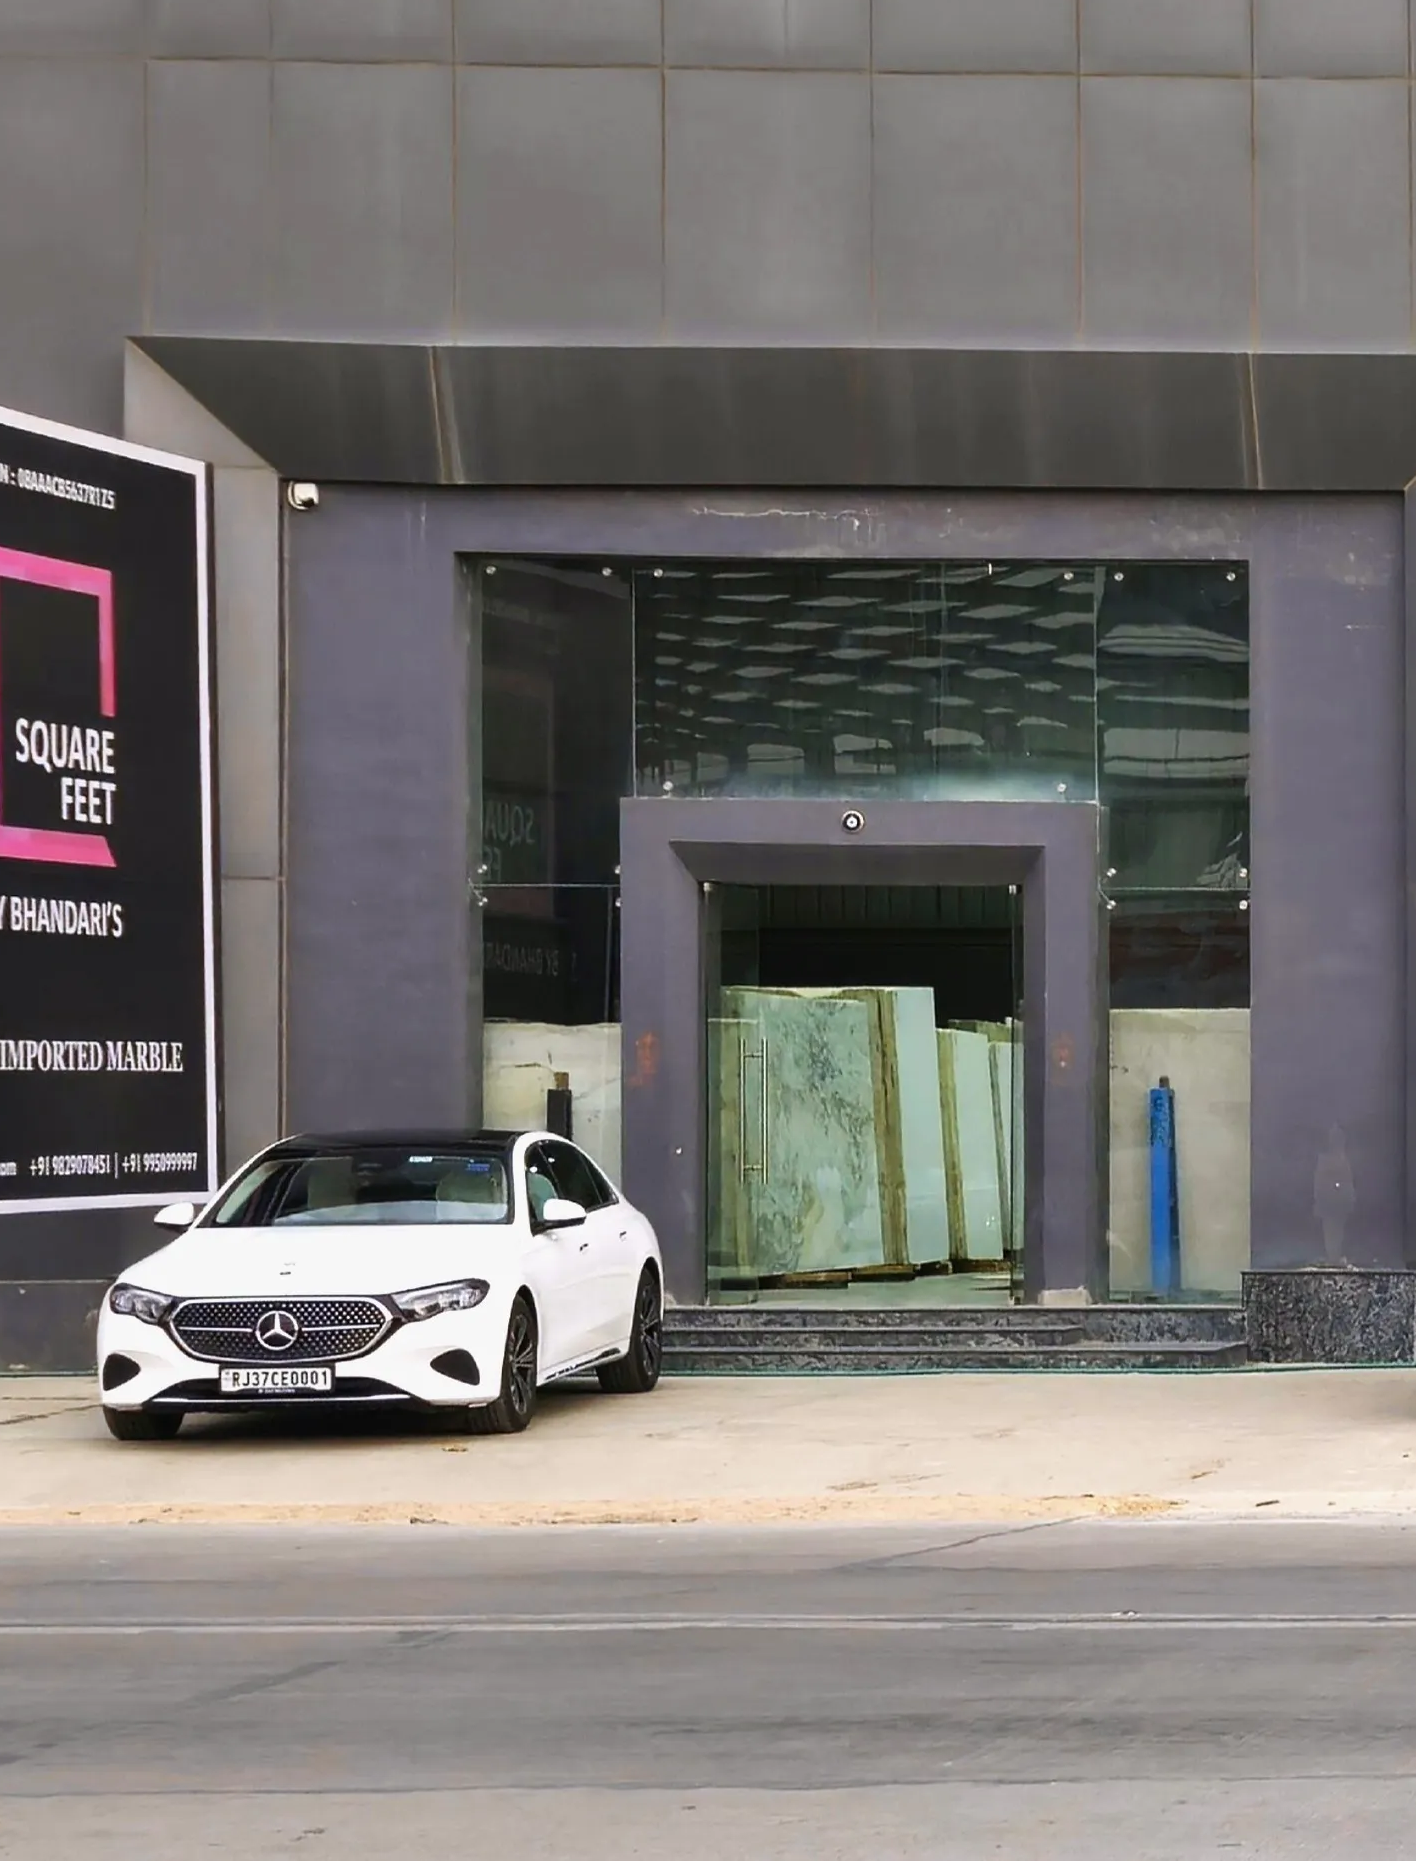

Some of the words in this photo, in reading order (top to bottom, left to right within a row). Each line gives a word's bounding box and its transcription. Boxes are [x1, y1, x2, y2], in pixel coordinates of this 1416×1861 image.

[15, 718, 115, 774] SQUARE
[61, 777, 116, 825] FEET
[10, 896, 122, 938] BHANDARI'S
[0, 1040, 104, 1072] IMPORTED
[106, 1041, 183, 1072] MARBLE
[30, 1155, 50, 1176] +91
[52, 1154, 110, 1176] 9829078451
[122, 1153, 141, 1173] +91
[232, 1370, 327, 1387] RJ37CE0001
